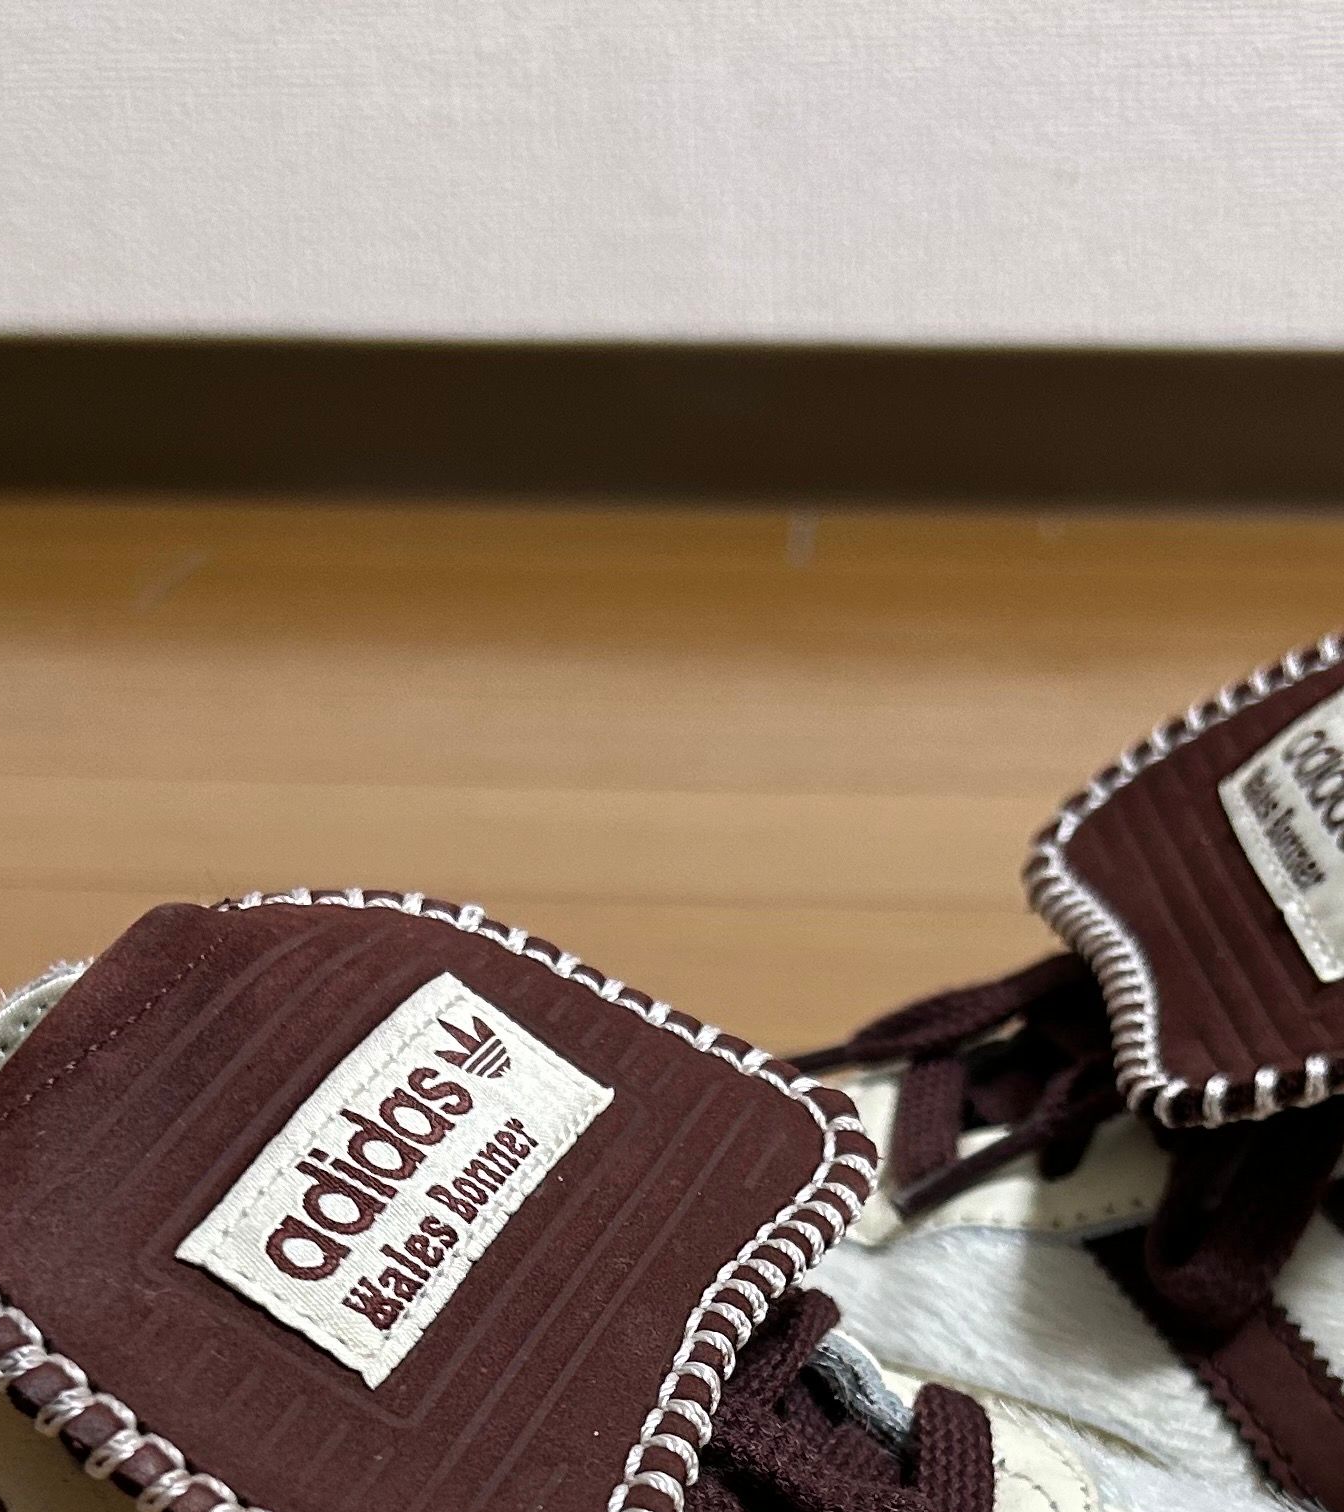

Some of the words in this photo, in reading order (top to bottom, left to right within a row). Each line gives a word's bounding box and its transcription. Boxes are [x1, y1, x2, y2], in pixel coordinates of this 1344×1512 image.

[264, 1066, 474, 1281] adidas
[341, 1214, 460, 1332] Wales
[425, 1116, 540, 1224] Bonner
